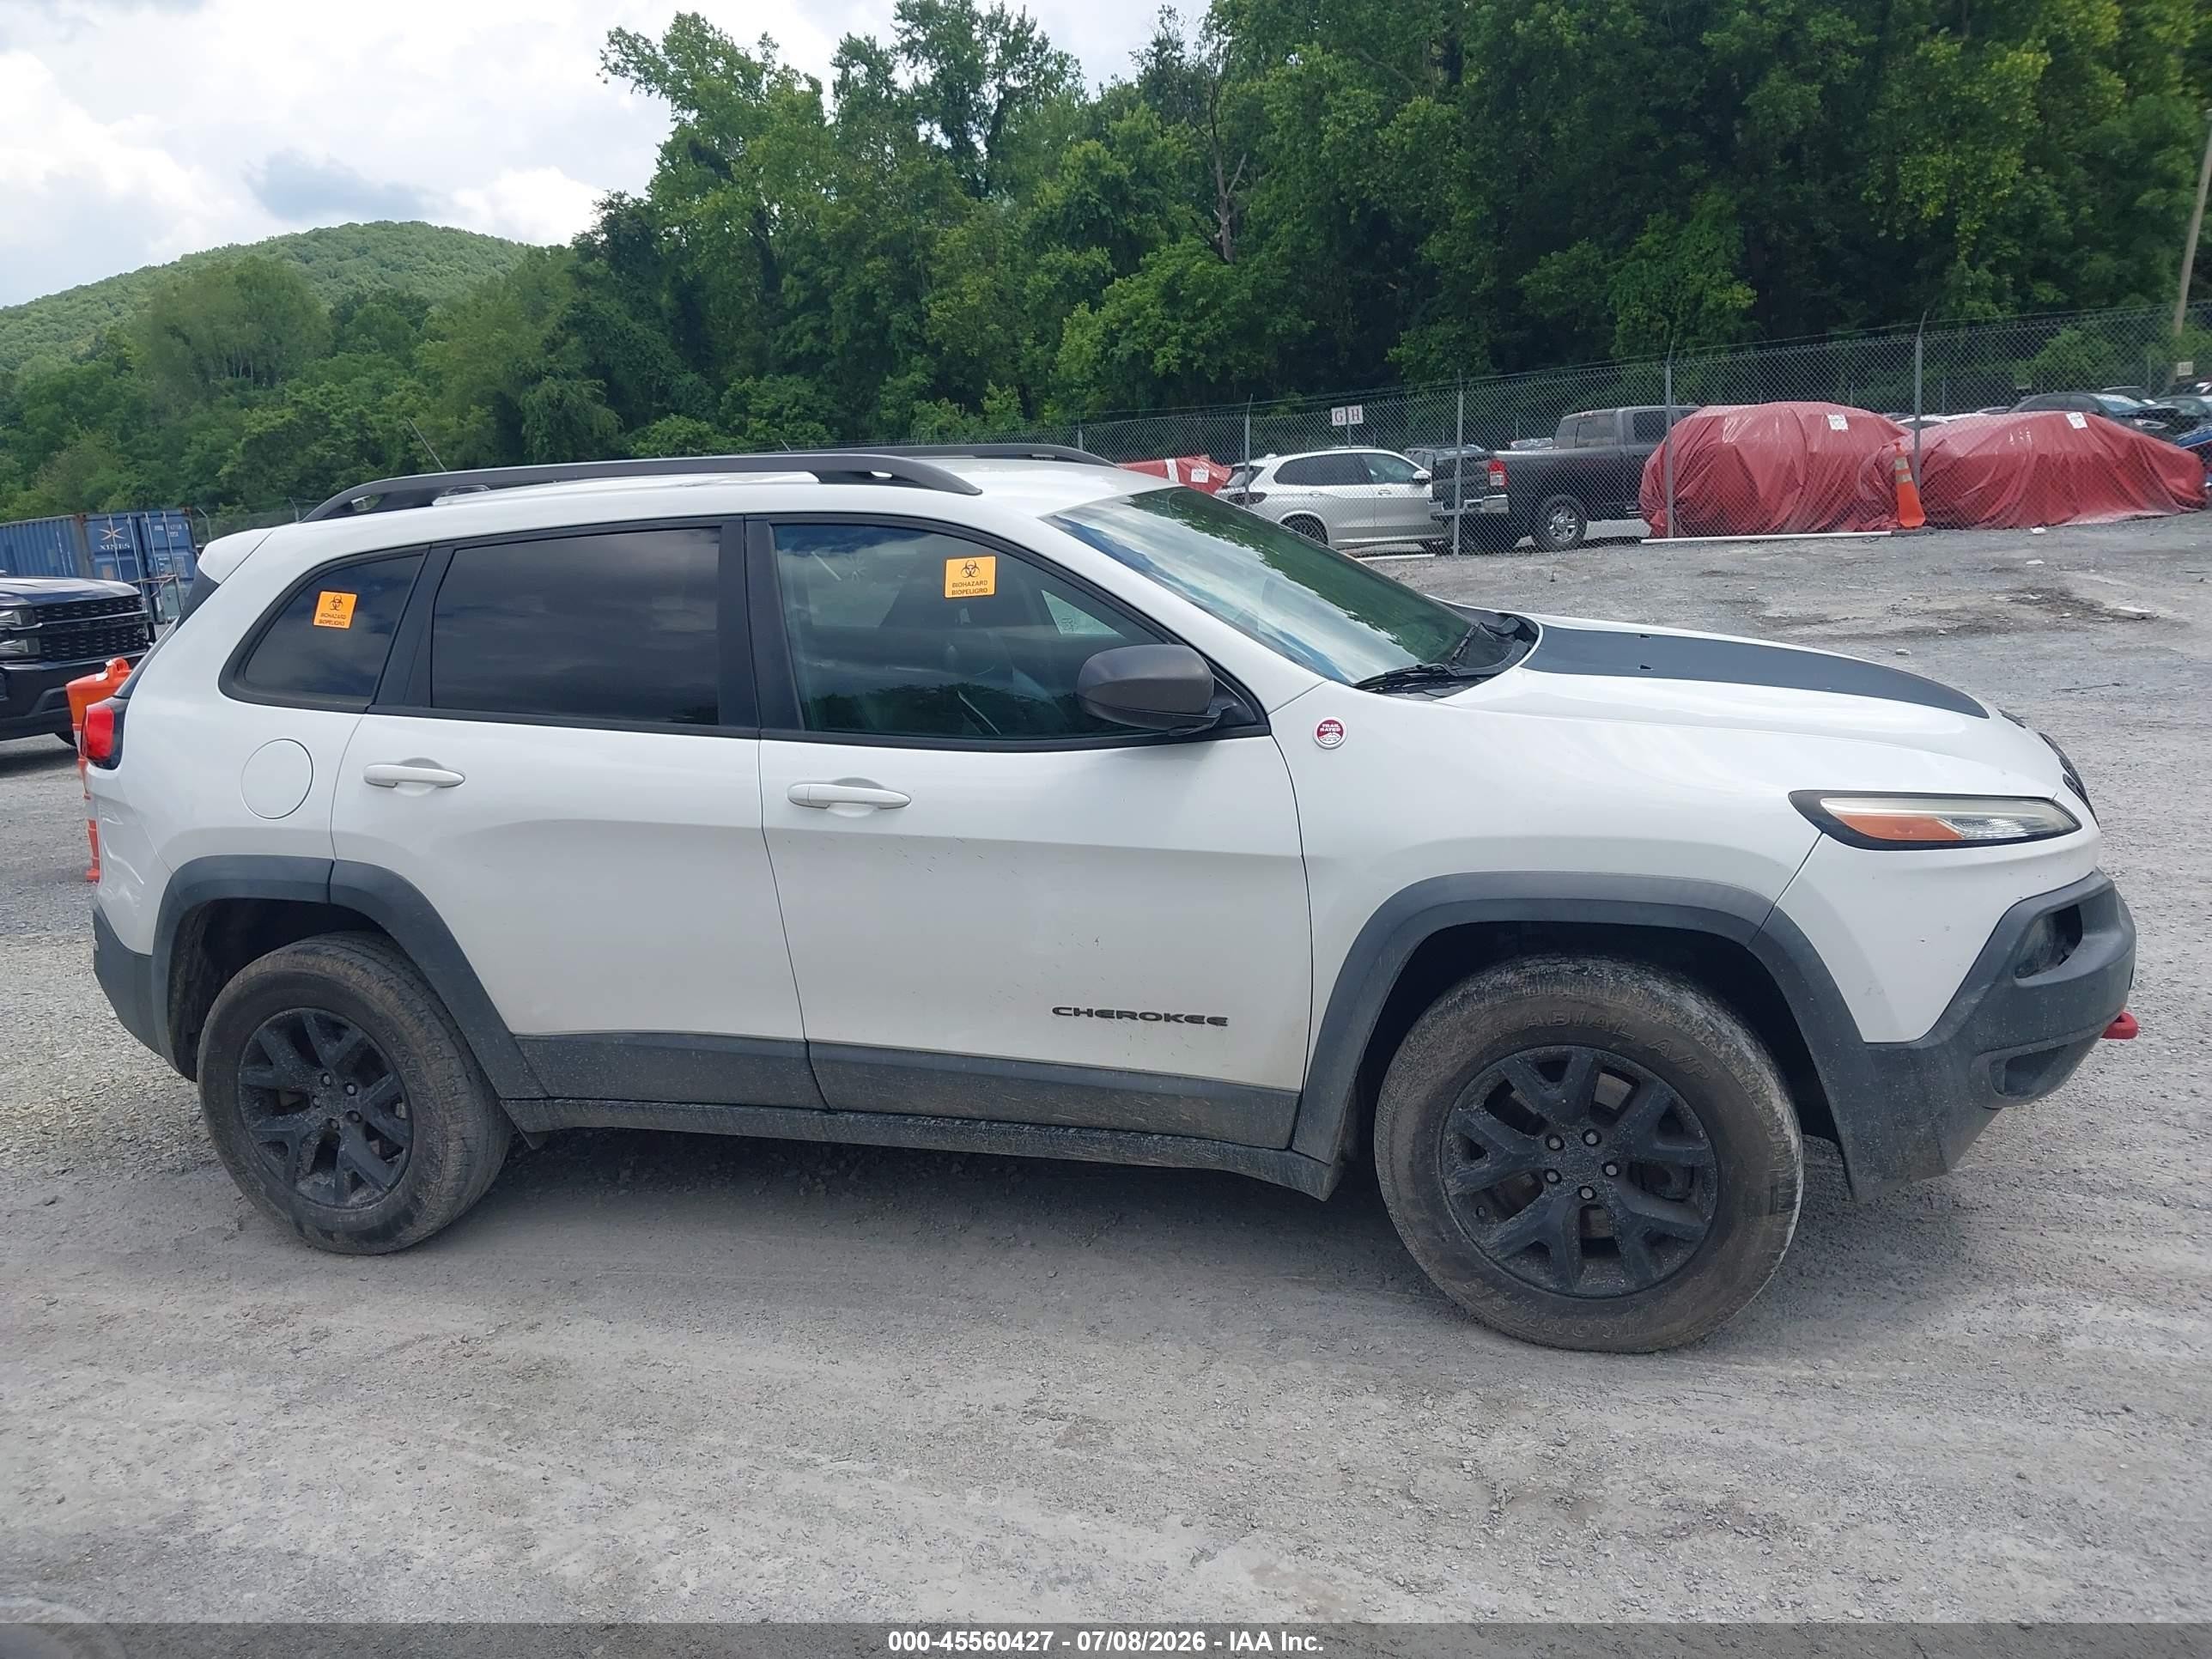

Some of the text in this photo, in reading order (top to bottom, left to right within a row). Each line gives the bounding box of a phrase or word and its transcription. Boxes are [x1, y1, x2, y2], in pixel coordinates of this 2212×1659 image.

[1334, 410, 1344, 423] G
[1351, 408, 1361, 422] H
[951, 580, 988, 588] BIOHAZARD
[951, 587, 988, 596] BIOPELIGRO
[1051, 1006, 1229, 1027] CHEROKEE
[1492, 1008, 1637, 1042] RADIAL
